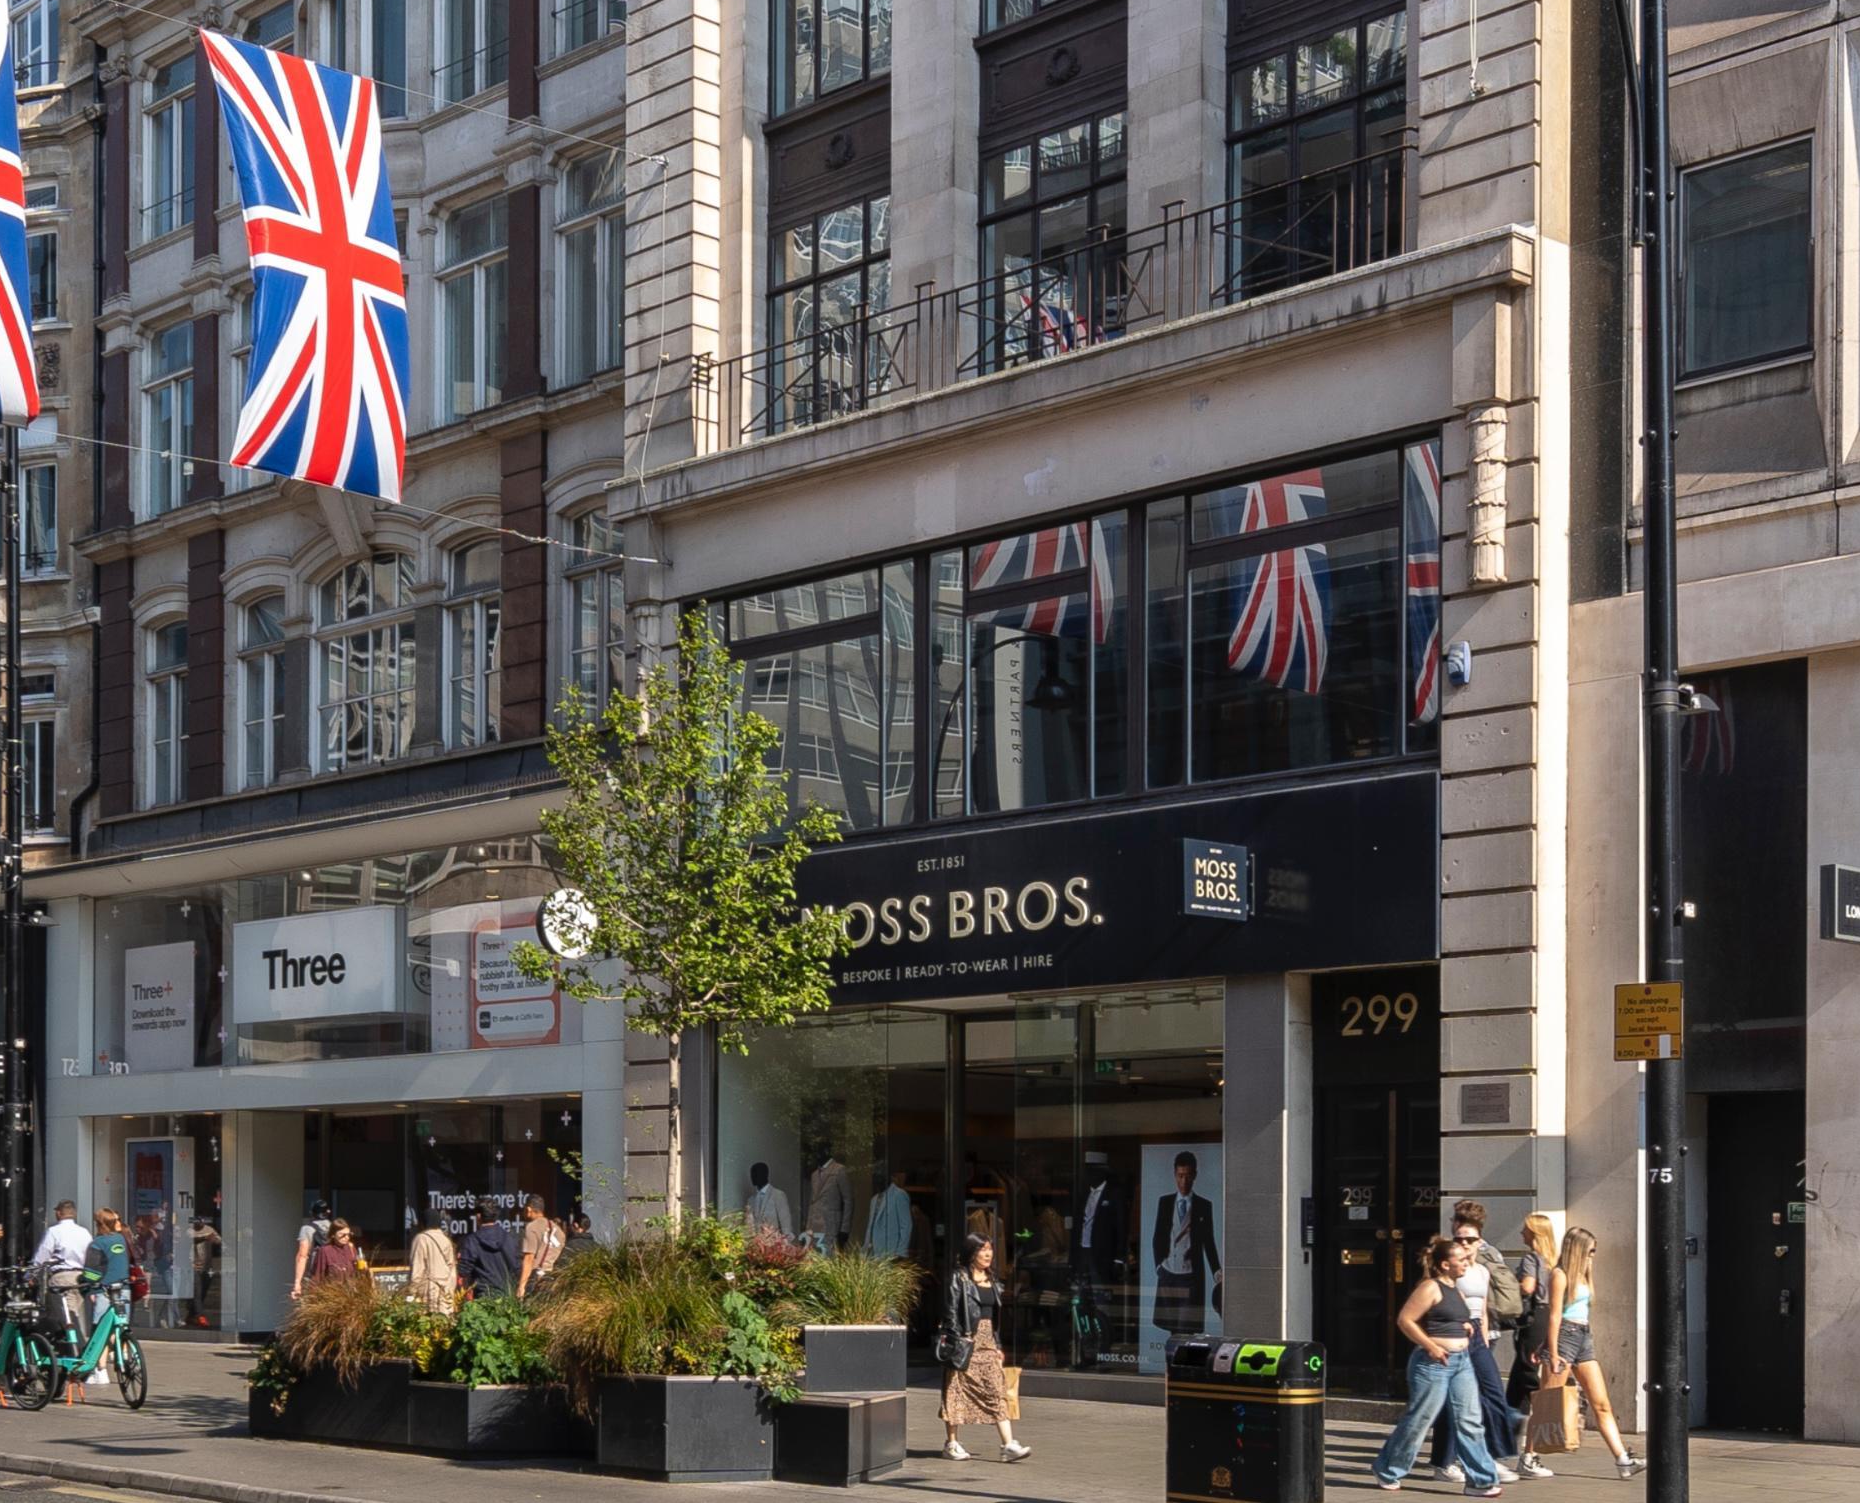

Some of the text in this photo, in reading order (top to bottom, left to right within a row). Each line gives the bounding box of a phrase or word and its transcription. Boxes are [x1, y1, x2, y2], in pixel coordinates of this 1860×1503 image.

[1194, 857, 1237, 880] MOSS
[1195, 879, 1241, 902] BROS.
[948, 876, 1104, 939] BROS.
[262, 949, 346, 990] Three
[842, 968, 892, 984] BESPOKE
[1023, 954, 1054, 969] HIRE
[132, 1006, 176, 1020] Download the
[1341, 992, 1419, 1037] 299
[132, 1018, 187, 1032] rewards app now
[1648, 1167, 1674, 1184] 75
[427, 1190, 477, 1209] There's
[1343, 1187, 1373, 1206] 299
